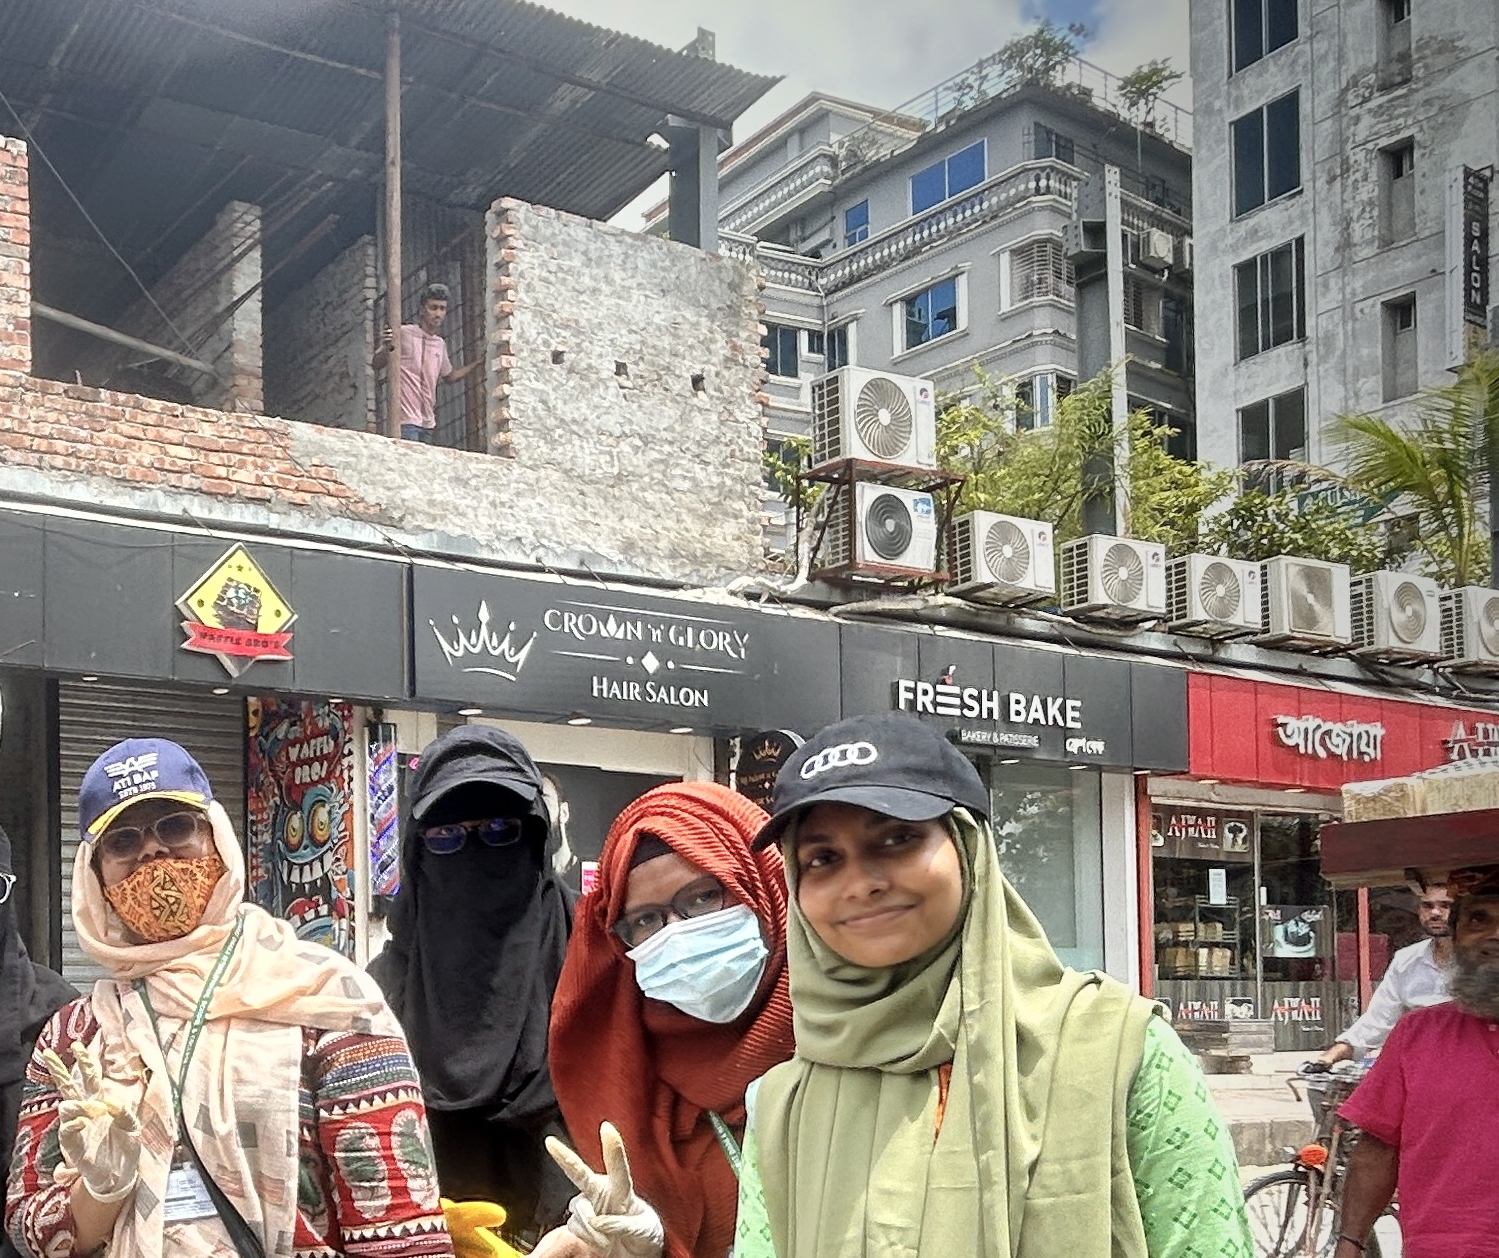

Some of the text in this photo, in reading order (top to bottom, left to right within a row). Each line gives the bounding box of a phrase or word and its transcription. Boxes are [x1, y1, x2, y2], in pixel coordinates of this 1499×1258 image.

[1470, 221, 1481, 305] SALON
[544, 609, 643, 642] CROWN
[668, 625, 749, 660] GLORY
[592, 676, 709, 708] HAIR SALON
[898, 678, 1082, 729] FRESH BAKE
[1276, 715, 1386, 762] আজোয়া
